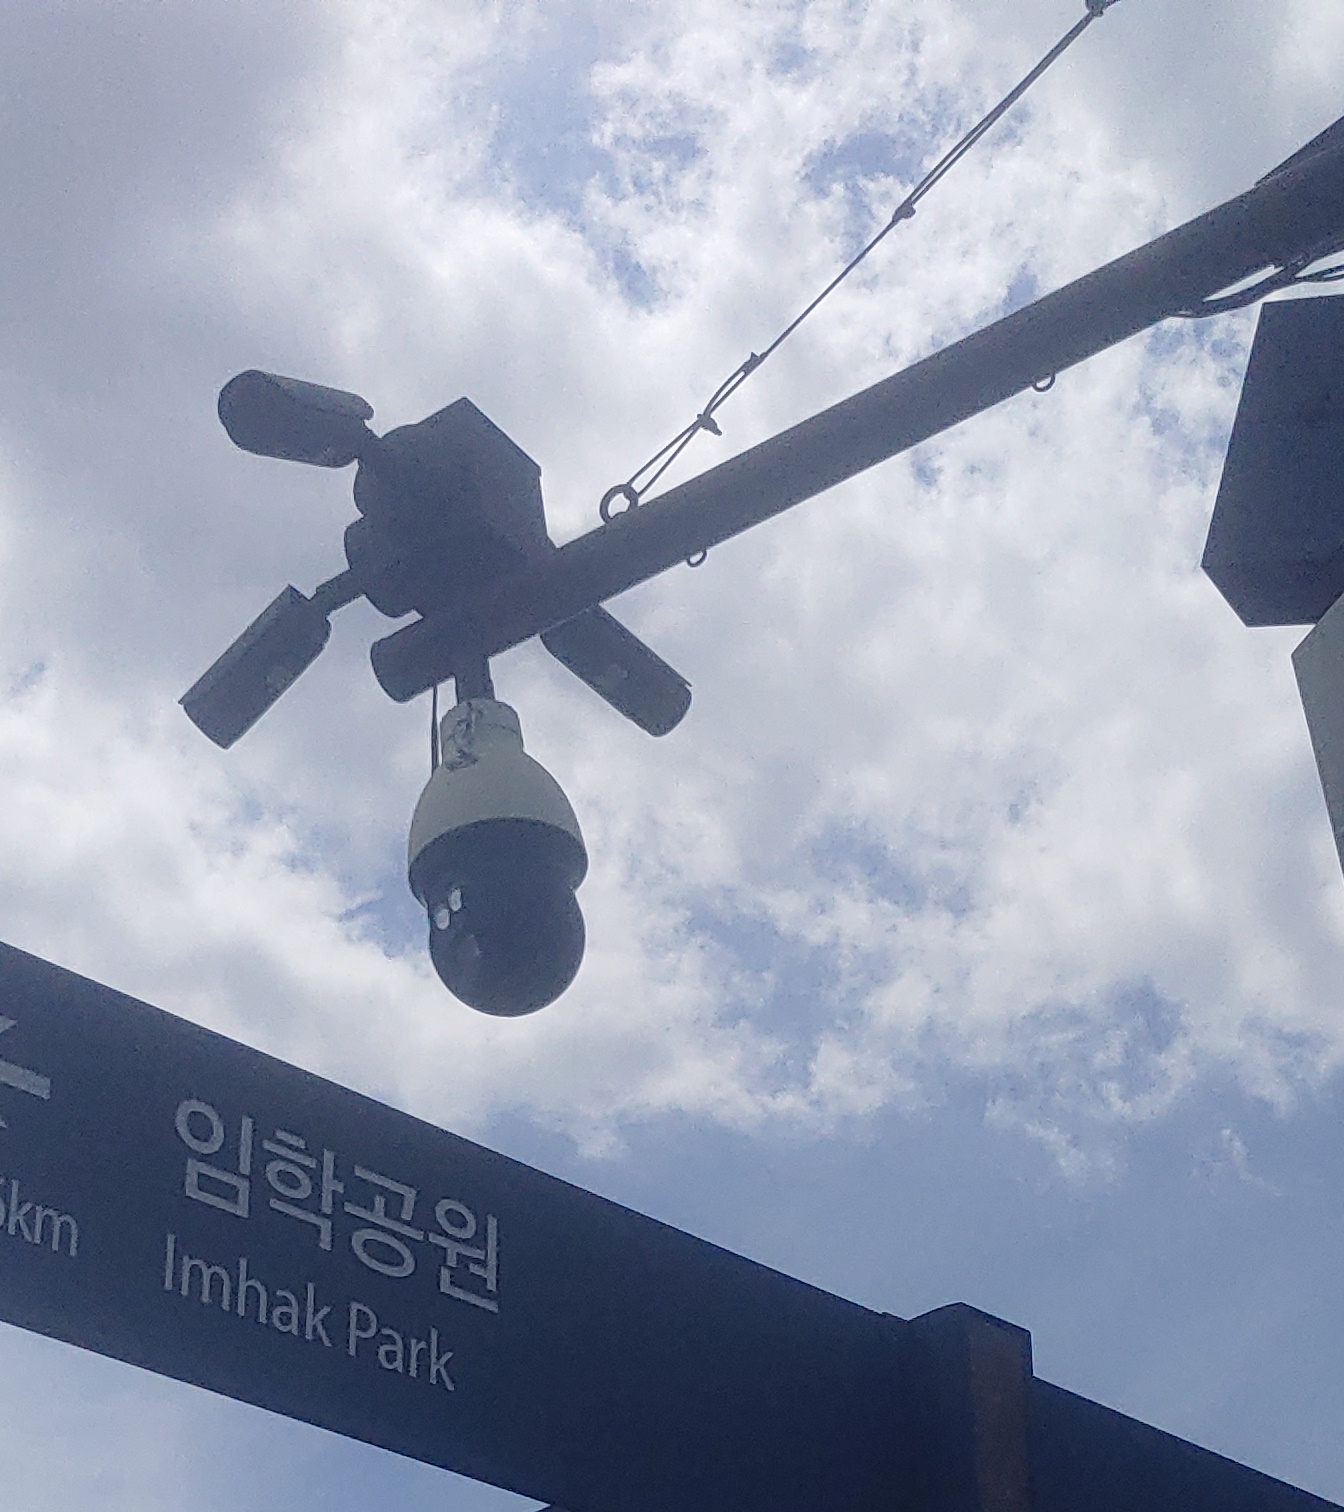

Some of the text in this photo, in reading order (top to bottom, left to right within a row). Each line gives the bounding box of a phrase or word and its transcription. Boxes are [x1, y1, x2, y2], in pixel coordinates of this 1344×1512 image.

[175, 1099, 499, 1313] 임학공원
[163, 1234, 455, 1392] Imhak Park
